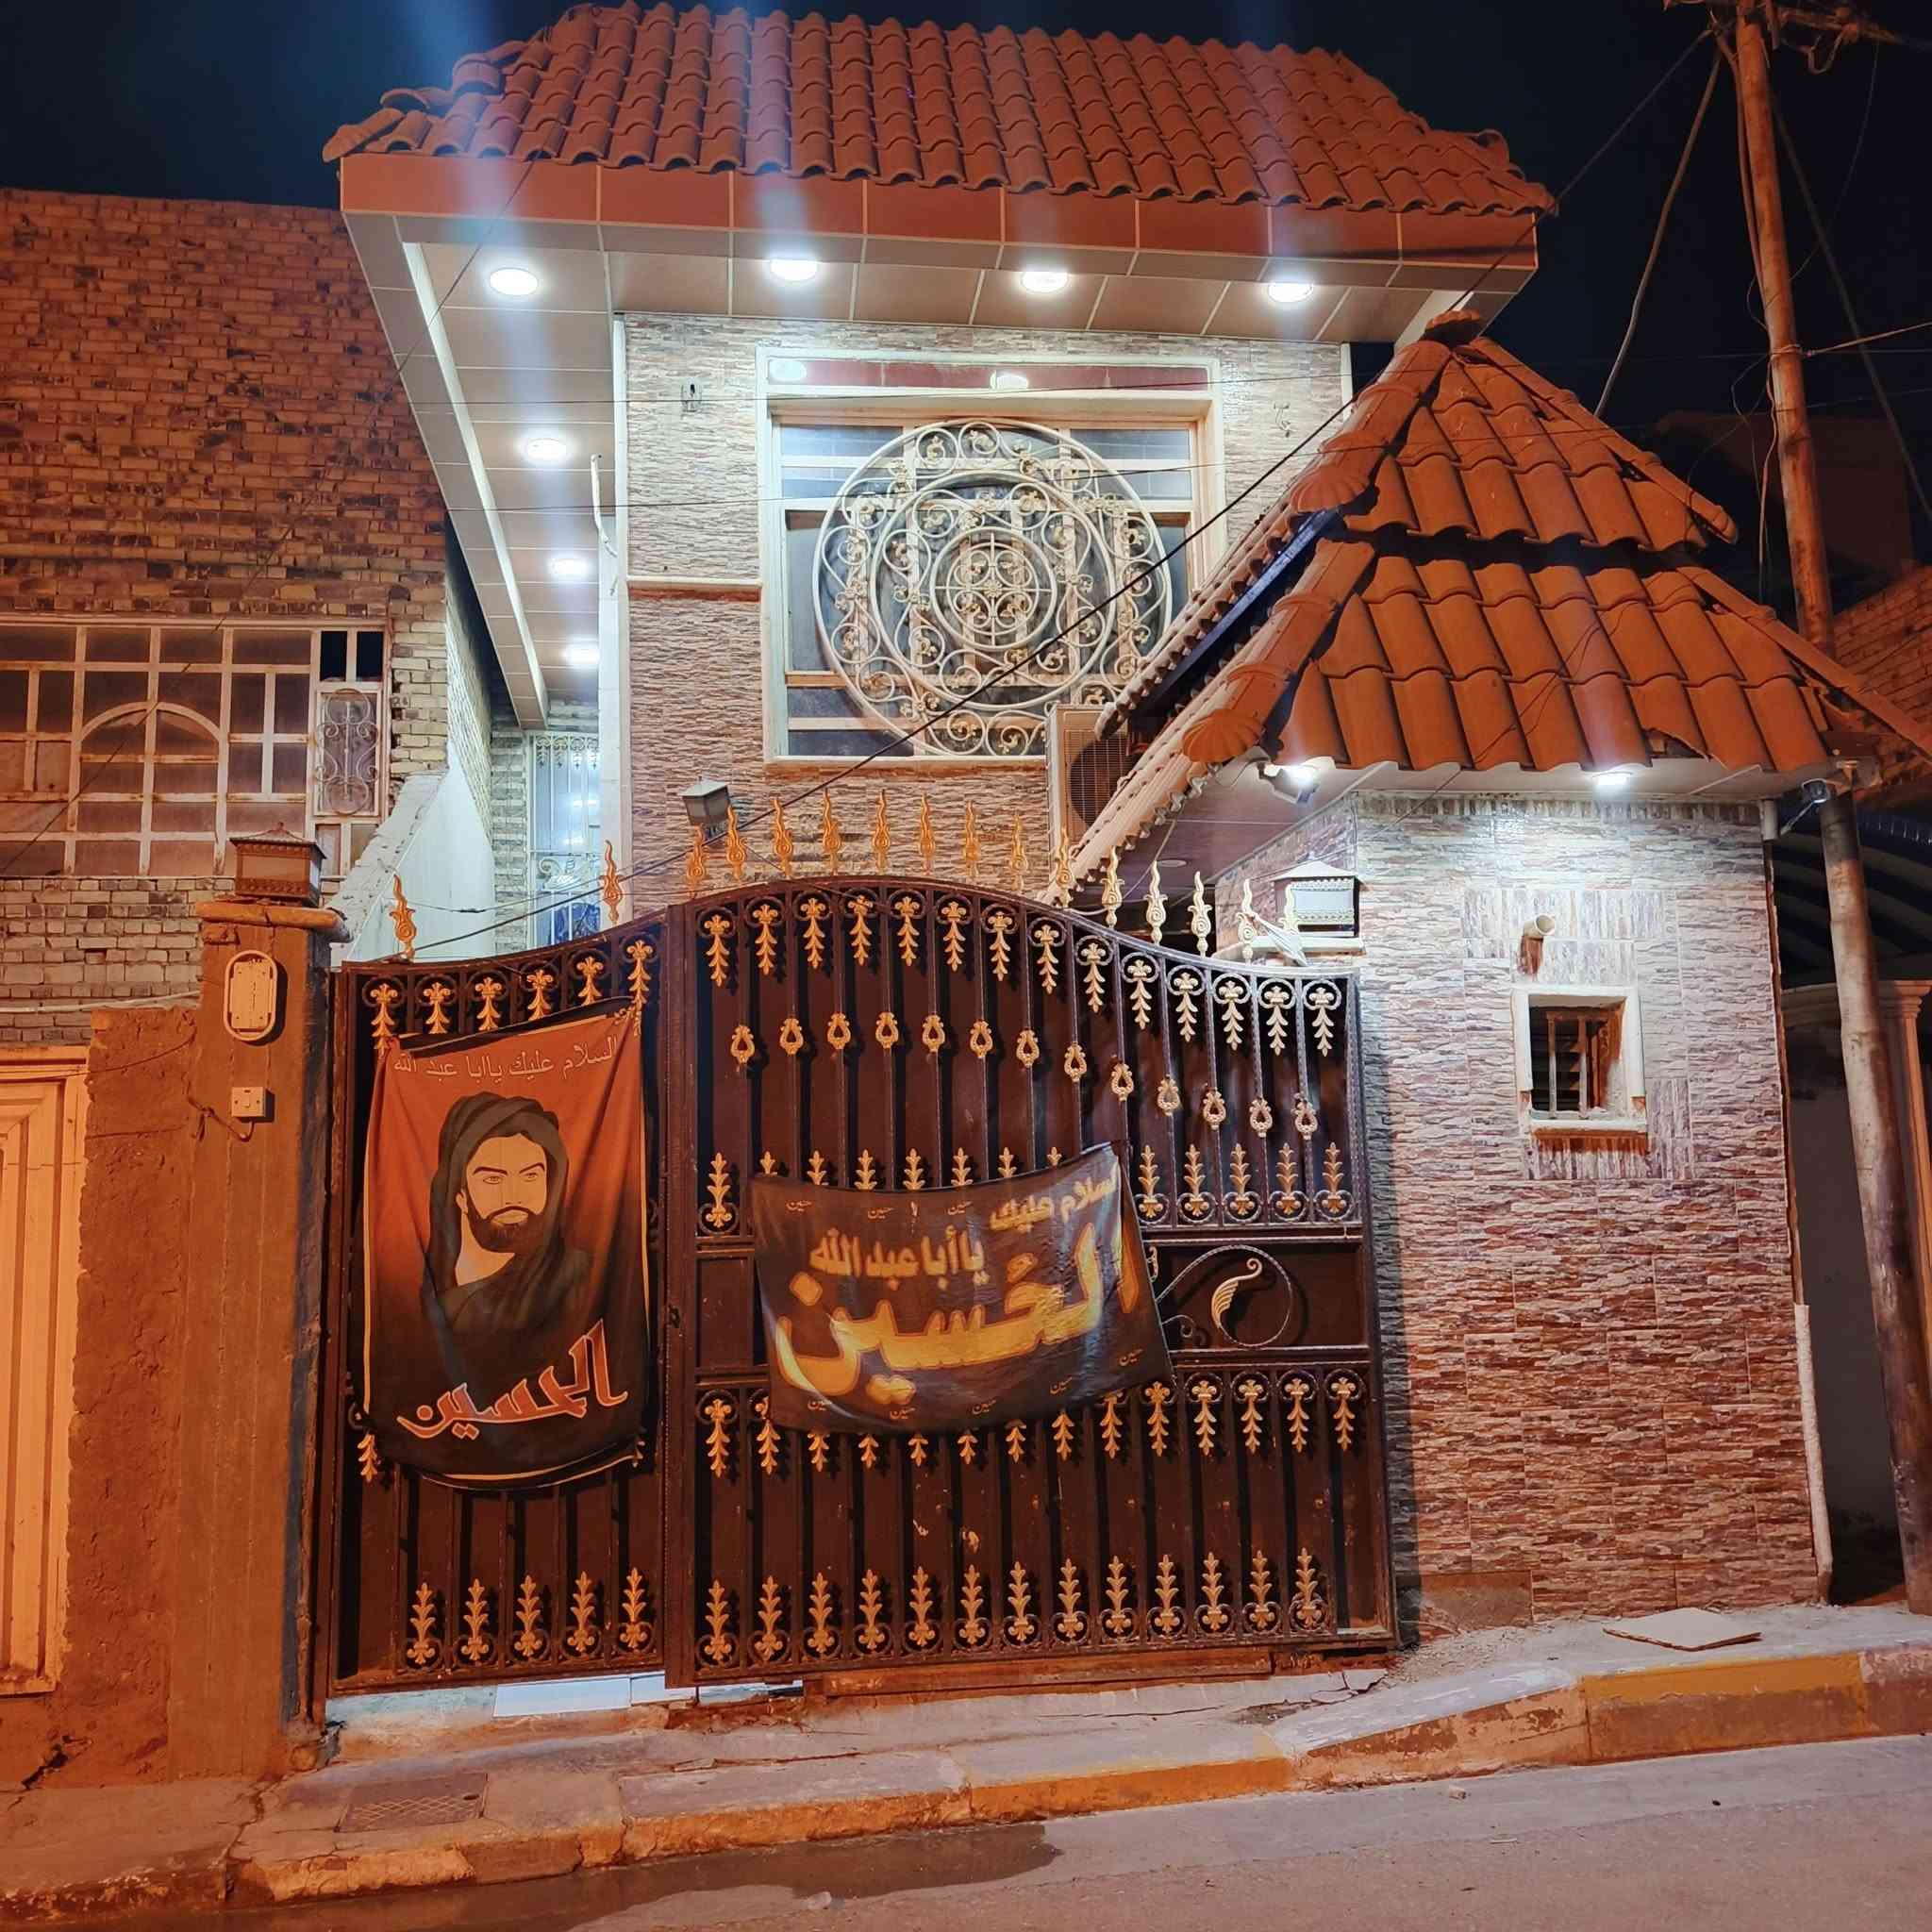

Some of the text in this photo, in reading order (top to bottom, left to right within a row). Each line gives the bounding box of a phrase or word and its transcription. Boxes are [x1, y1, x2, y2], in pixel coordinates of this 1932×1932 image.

[393, 1052, 417, 1073] الله
[426, 1059, 458, 1082] عبد
[508, 1050, 555, 1081] عليك
[563, 1035, 618, 1079] السلام
[990, 1194, 1054, 1233] عليك
[808, 1226, 862, 1277] الله
[865, 1240, 920, 1291] عبد
[396, 1318, 628, 1441] الحسين
